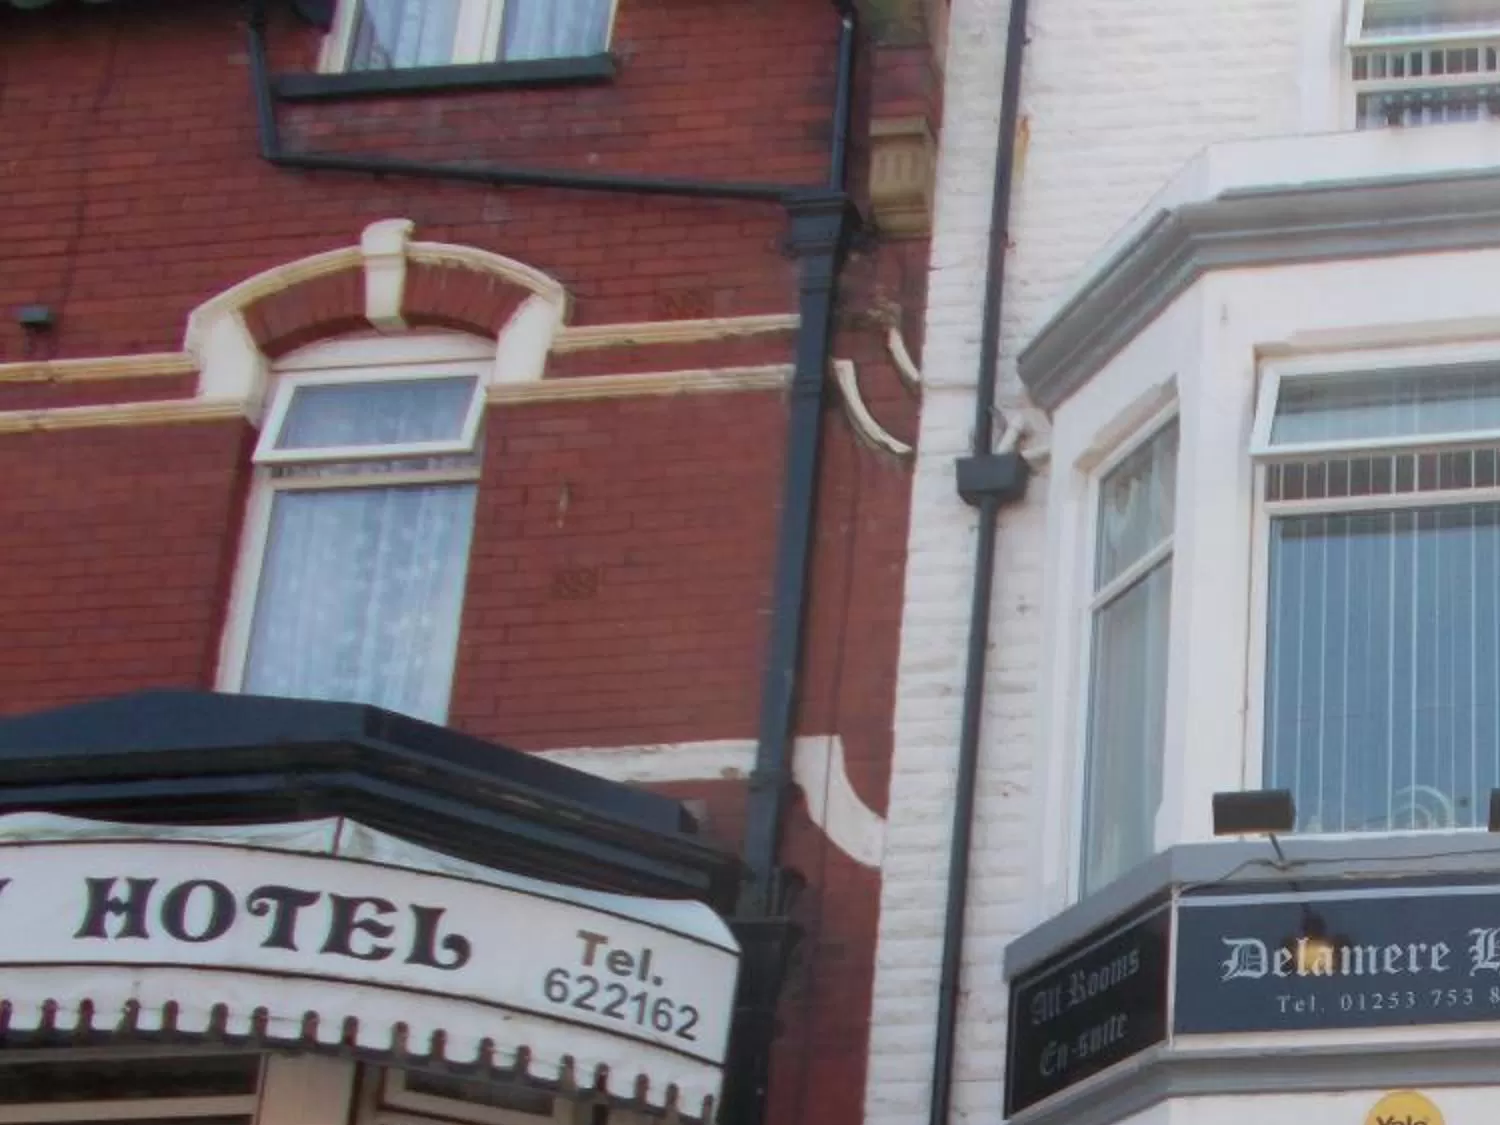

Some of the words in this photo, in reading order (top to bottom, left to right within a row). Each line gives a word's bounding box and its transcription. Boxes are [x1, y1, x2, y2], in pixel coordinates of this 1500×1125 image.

[72, 876, 472, 971] HOTEL
[576, 929, 664, 987] Tel.
[1067, 948, 1141, 1008] Rooms
[1221, 936, 1450, 982] Delamere
[543, 967, 699, 1042] 622162
[1277, 994, 1325, 1014] Tel.
[1340, 990, 1417, 1012] 01253
[1431, 987, 1475, 1007] 753
